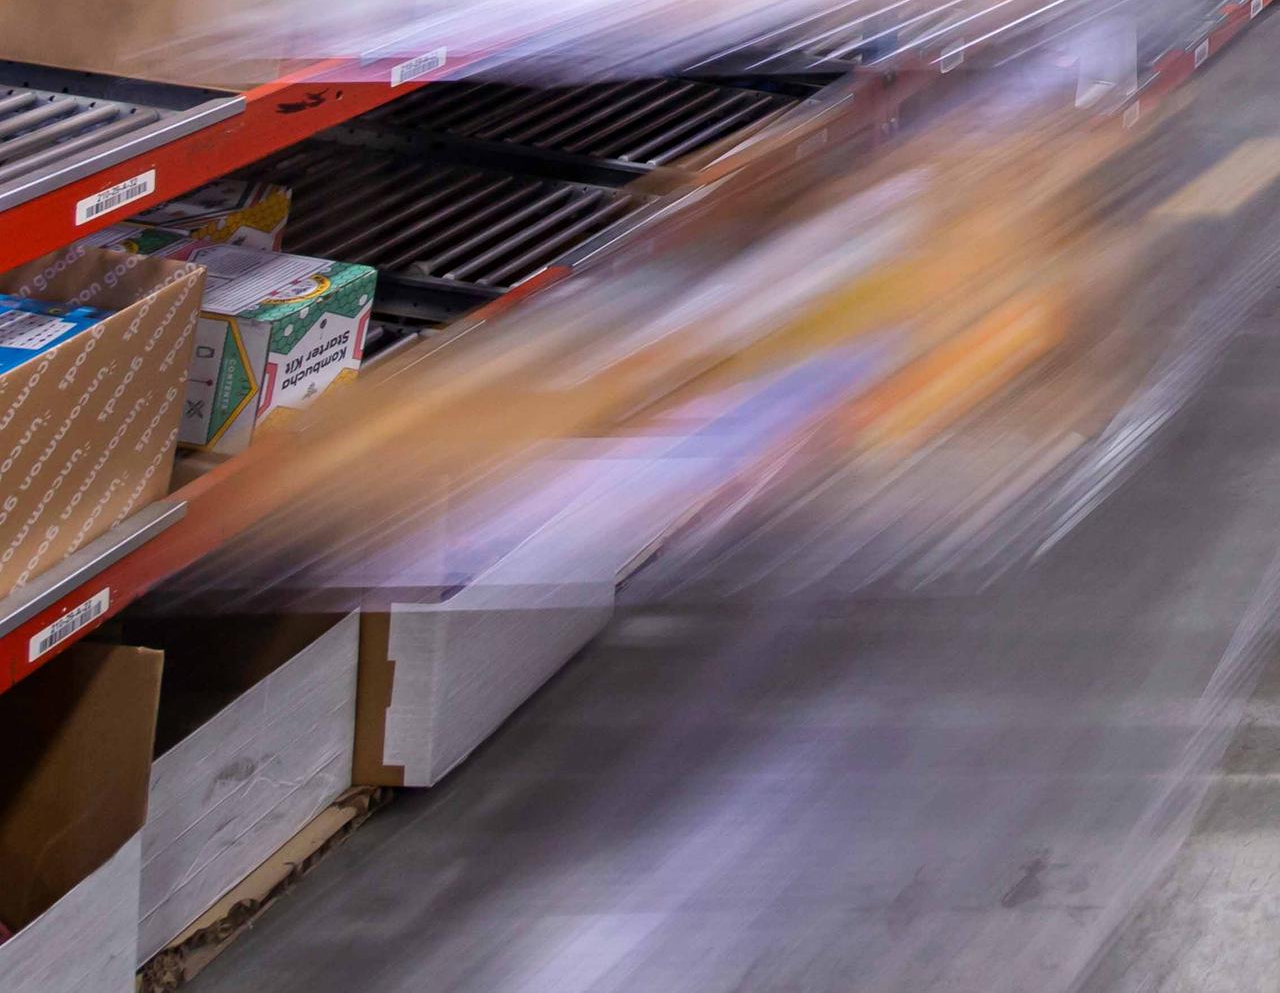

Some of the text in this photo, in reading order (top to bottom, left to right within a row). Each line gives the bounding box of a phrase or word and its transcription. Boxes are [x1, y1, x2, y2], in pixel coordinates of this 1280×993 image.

[33, 245, 87, 292] goods
[58, 324, 106, 392] goods
[280, 346, 348, 391] Kombucha
[284, 329, 351, 375] Starter Kit
[97, 356, 144, 423] goods
[134, 386, 178, 453] goods
